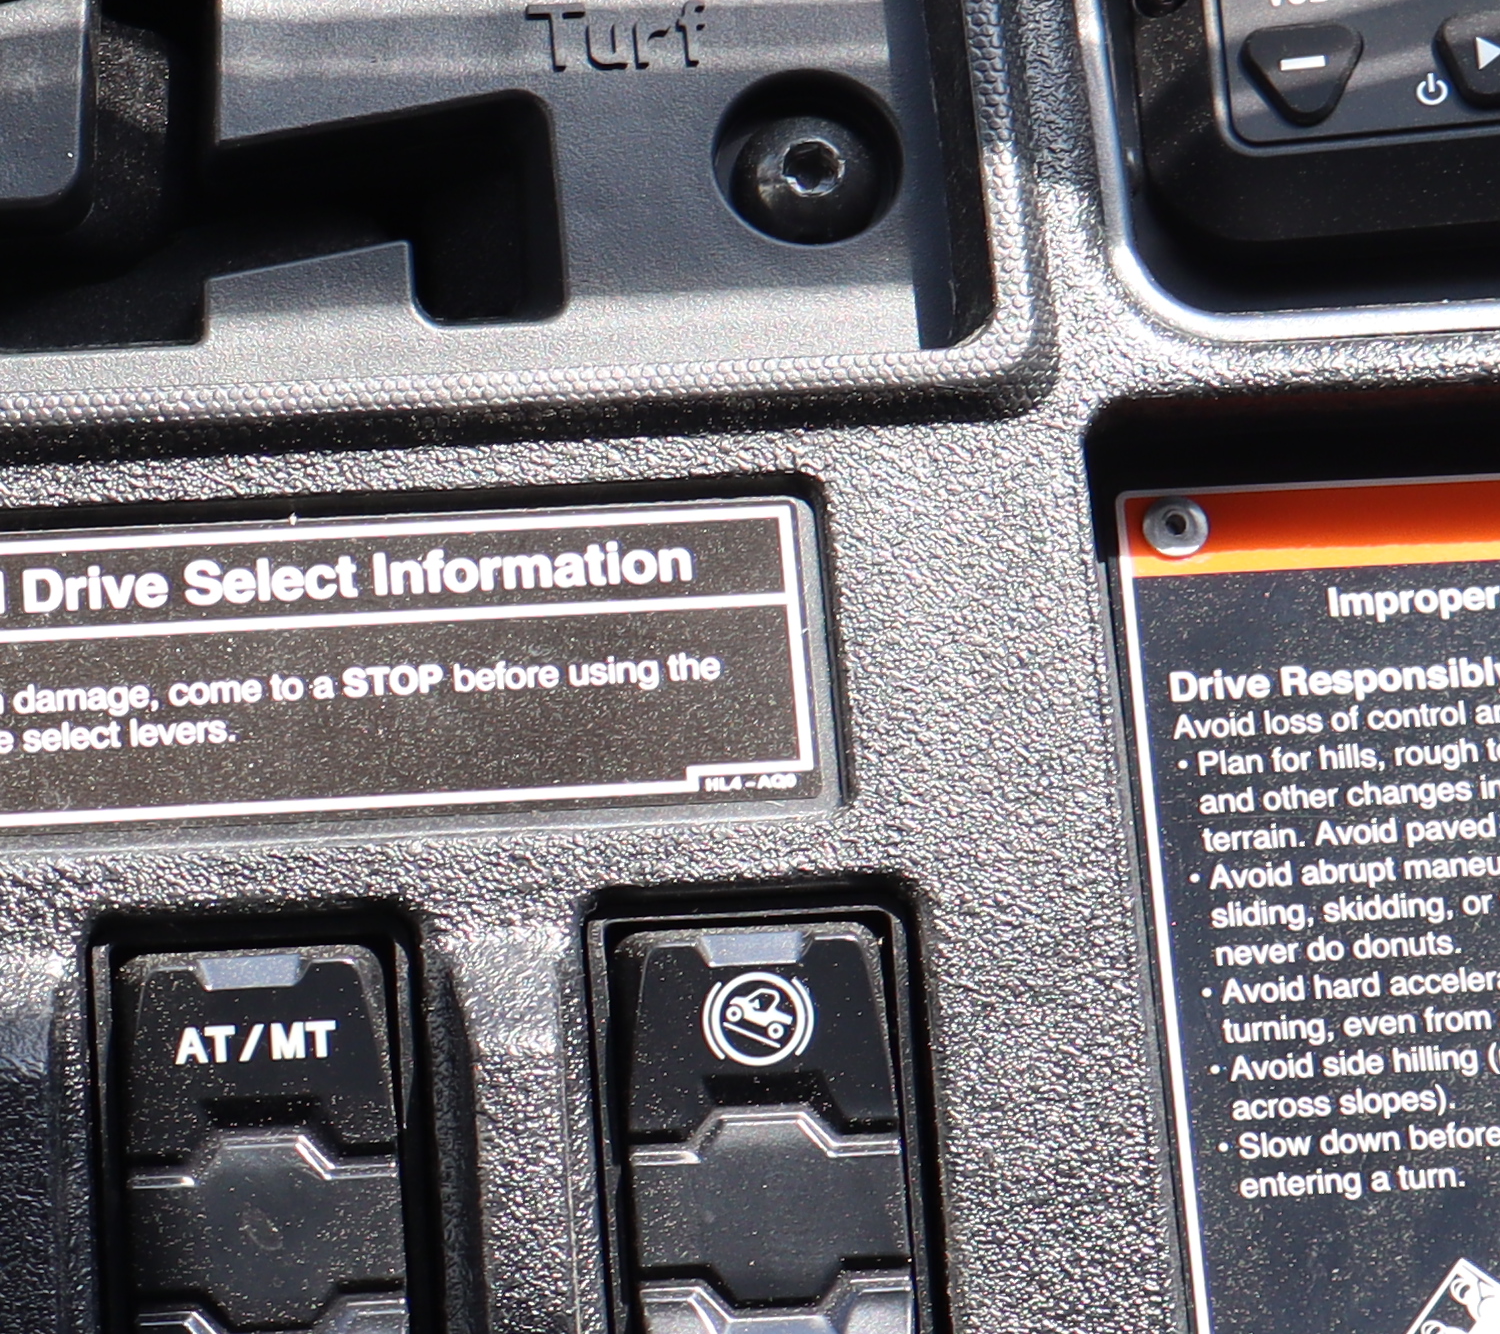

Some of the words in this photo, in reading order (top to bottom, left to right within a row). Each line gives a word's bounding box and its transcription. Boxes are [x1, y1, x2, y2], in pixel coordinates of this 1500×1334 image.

[524, 0, 706, 72] Turf
[22, 565, 169, 613] Drive
[184, 556, 359, 606] Select
[373, 541, 693, 596] Information
[1328, 586, 1500, 623] Improper
[13, 684, 159, 717] damage,
[168, 679, 262, 707] come
[270, 673, 304, 701] to
[313, 676, 335, 699] a
[342, 664, 443, 698] STOP
[453, 660, 559, 692] before
[569, 656, 660, 690] using
[667, 652, 721, 681] the
[1170, 669, 1270, 702] Drive
[23, 721, 121, 753] select
[130, 718, 236, 747] levers.
[1174, 711, 1255, 739] Avoid
[1264, 710, 1323, 735] loss
[1331, 705, 1359, 732] of
[1367, 700, 1466, 730] control
[1198, 750, 1263, 776] Plan
[1272, 747, 1311, 772] for
[1319, 743, 1385, 771] hills,
[1395, 738, 1479, 770] rough
[1210, 861, 1292, 889] Avoid
[1302, 857, 1396, 888] abrupt
[1222, 975, 1305, 1004] Avoid
[1314, 971, 1380, 999] hard
[175, 1020, 337, 1065] AT/MT
[1239, 1132, 1311, 1159] Slow
[1320, 1128, 1401, 1155] down
